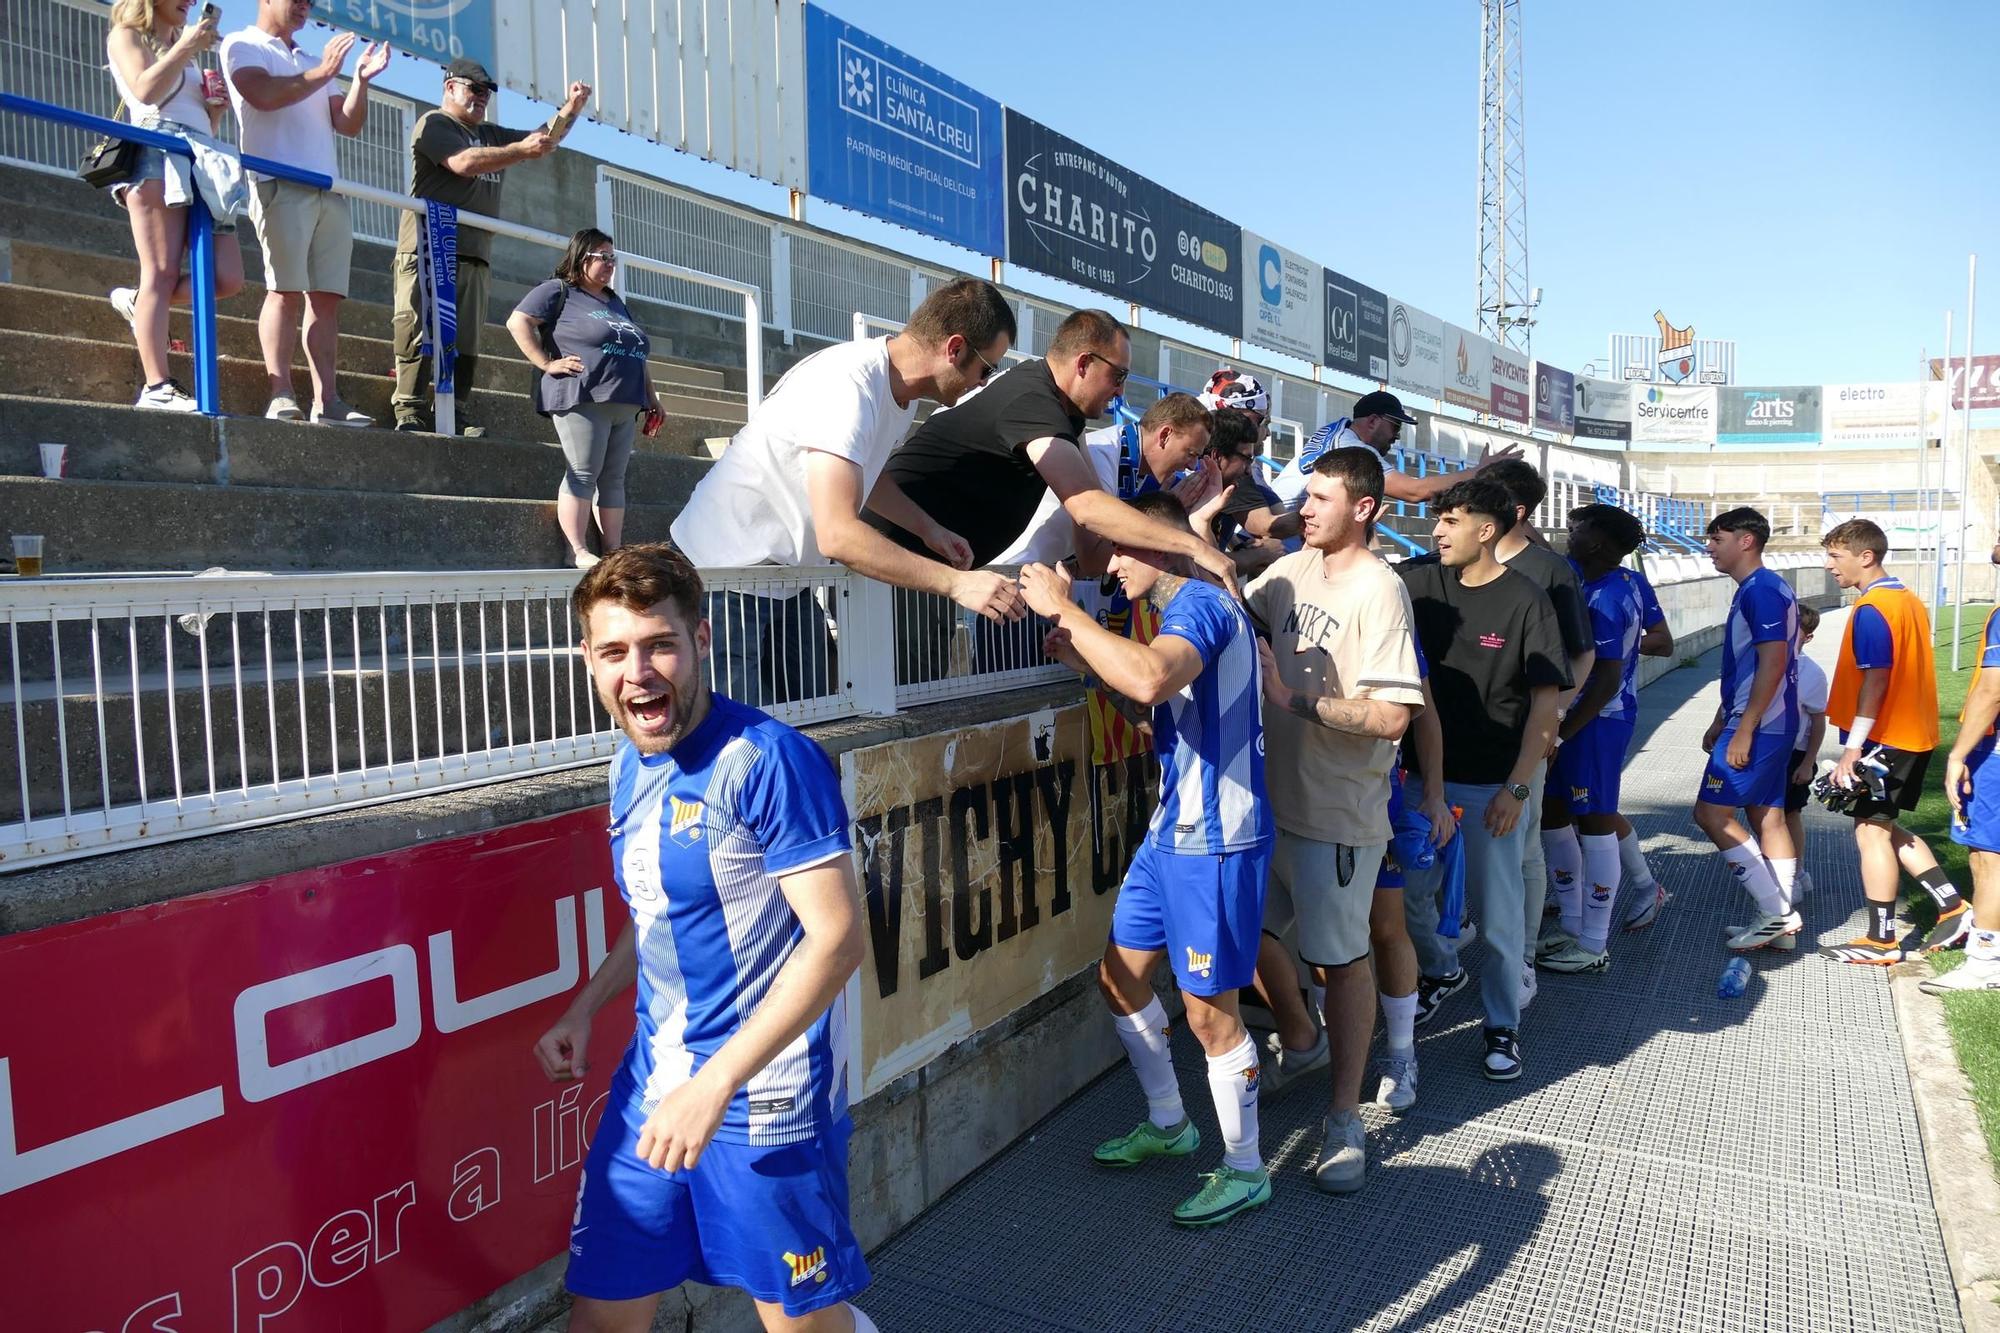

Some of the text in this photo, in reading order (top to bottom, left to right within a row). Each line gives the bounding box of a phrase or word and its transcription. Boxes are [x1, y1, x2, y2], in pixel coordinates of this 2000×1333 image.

[414, 22, 464, 59] 400
[885, 75, 927, 107] CLÍNICA
[886, 96, 972, 153] SANTA CREU
[846, 136, 891, 163] PARTNER
[914, 164, 944, 186] OFICIAL
[943, 177, 958, 193] DEL
[958, 183, 976, 200] CLUB
[1054, 151, 1128, 199] ENTREPANS D'AUTOR
[1017, 172, 1157, 263] CHARITO
[431, 227, 440, 249] SOM
[434, 257, 445, 287] SEREM
[1099, 268, 1116, 285] 1953
[1171, 263, 1234, 302] CHARITO1953
[1331, 305, 1354, 344] GC
[601, 342, 626, 356] Wine
[1638, 402, 1709, 419] Servicentre
[1840, 386, 1886, 400] electro
[1282, 602, 1340, 657] NIKE
[855, 759, 1076, 999] VICHY
[231, 1180, 416, 1333] per
[448, 1146, 502, 1222] a
